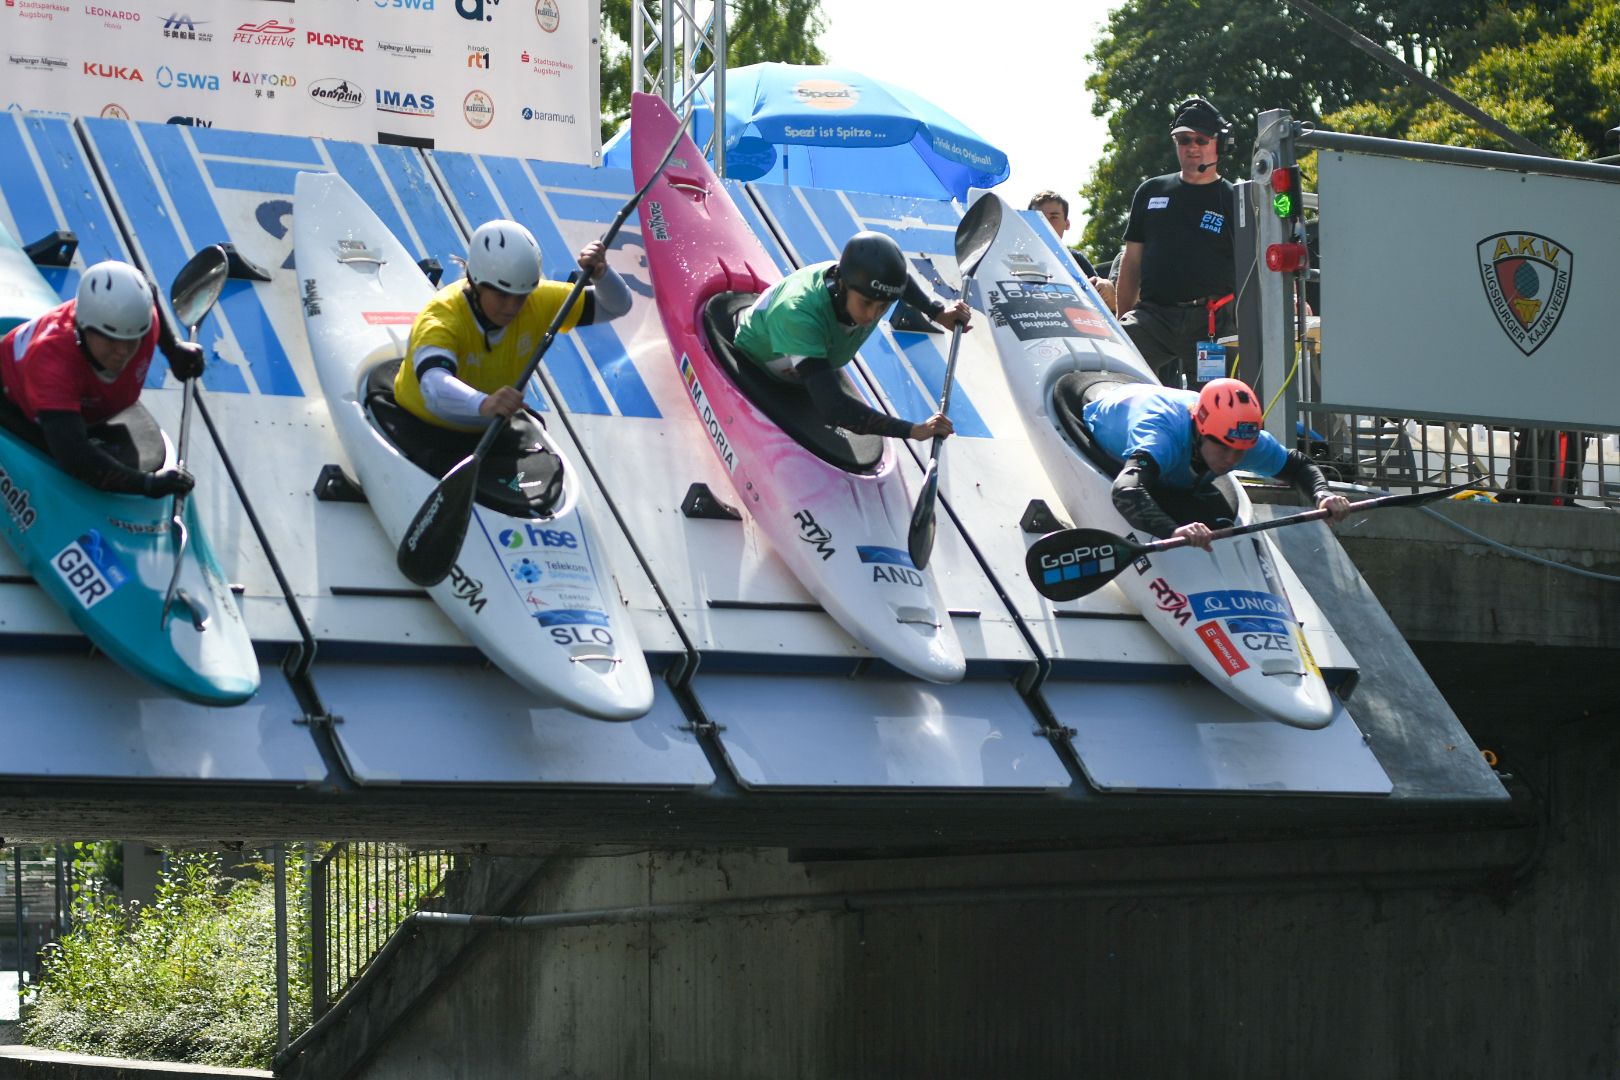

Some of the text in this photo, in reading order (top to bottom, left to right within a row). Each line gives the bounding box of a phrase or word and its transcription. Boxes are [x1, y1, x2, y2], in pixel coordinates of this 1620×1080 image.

[85, 6, 141, 21] LEONARDO
[233, 32, 296, 48] PEI SHENG
[467, 52, 490, 69] rt1
[533, 57, 574, 70] Stadtsparkasse
[84, 62, 144, 82] KUKA
[232, 70, 297, 87] KAYFORD
[533, 66, 561, 77] Augsburg
[177, 72, 220, 91] swa
[311, 86, 362, 102] dansprint
[375, 88, 435, 110] IMAS
[798, 88, 850, 98] Spezi
[534, 109, 576, 124] baramundi
[819, 126, 833, 138] ist
[836, 126, 872, 140] Spitze
[648, 201, 671, 240] PANAME
[1200, 222, 1221, 234] kanal
[1202, 213, 1224, 227] eis
[1493, 236, 1560, 267] A.K.V.
[303, 279, 321, 317] PANAME
[1007, 288, 1080, 303] GoPro
[1483, 262, 1526, 343] AUGSBURGER
[1010, 310, 1062, 320] pohybem
[1527, 270, 1568, 345] KAJAK-VEREIN
[703, 409, 736, 470] DORIA
[525, 524, 578, 549] hse
[793, 509, 836, 561] RTM
[1040, 543, 1114, 570] GoPro
[545, 561, 588, 572] Telekom
[57, 548, 107, 605] GBR
[873, 566, 924, 588] AND
[449, 563, 488, 615] RTM
[1149, 577, 1192, 627] RTM
[550, 627, 614, 645] SLO
[1242, 633, 1293, 652] CZE
